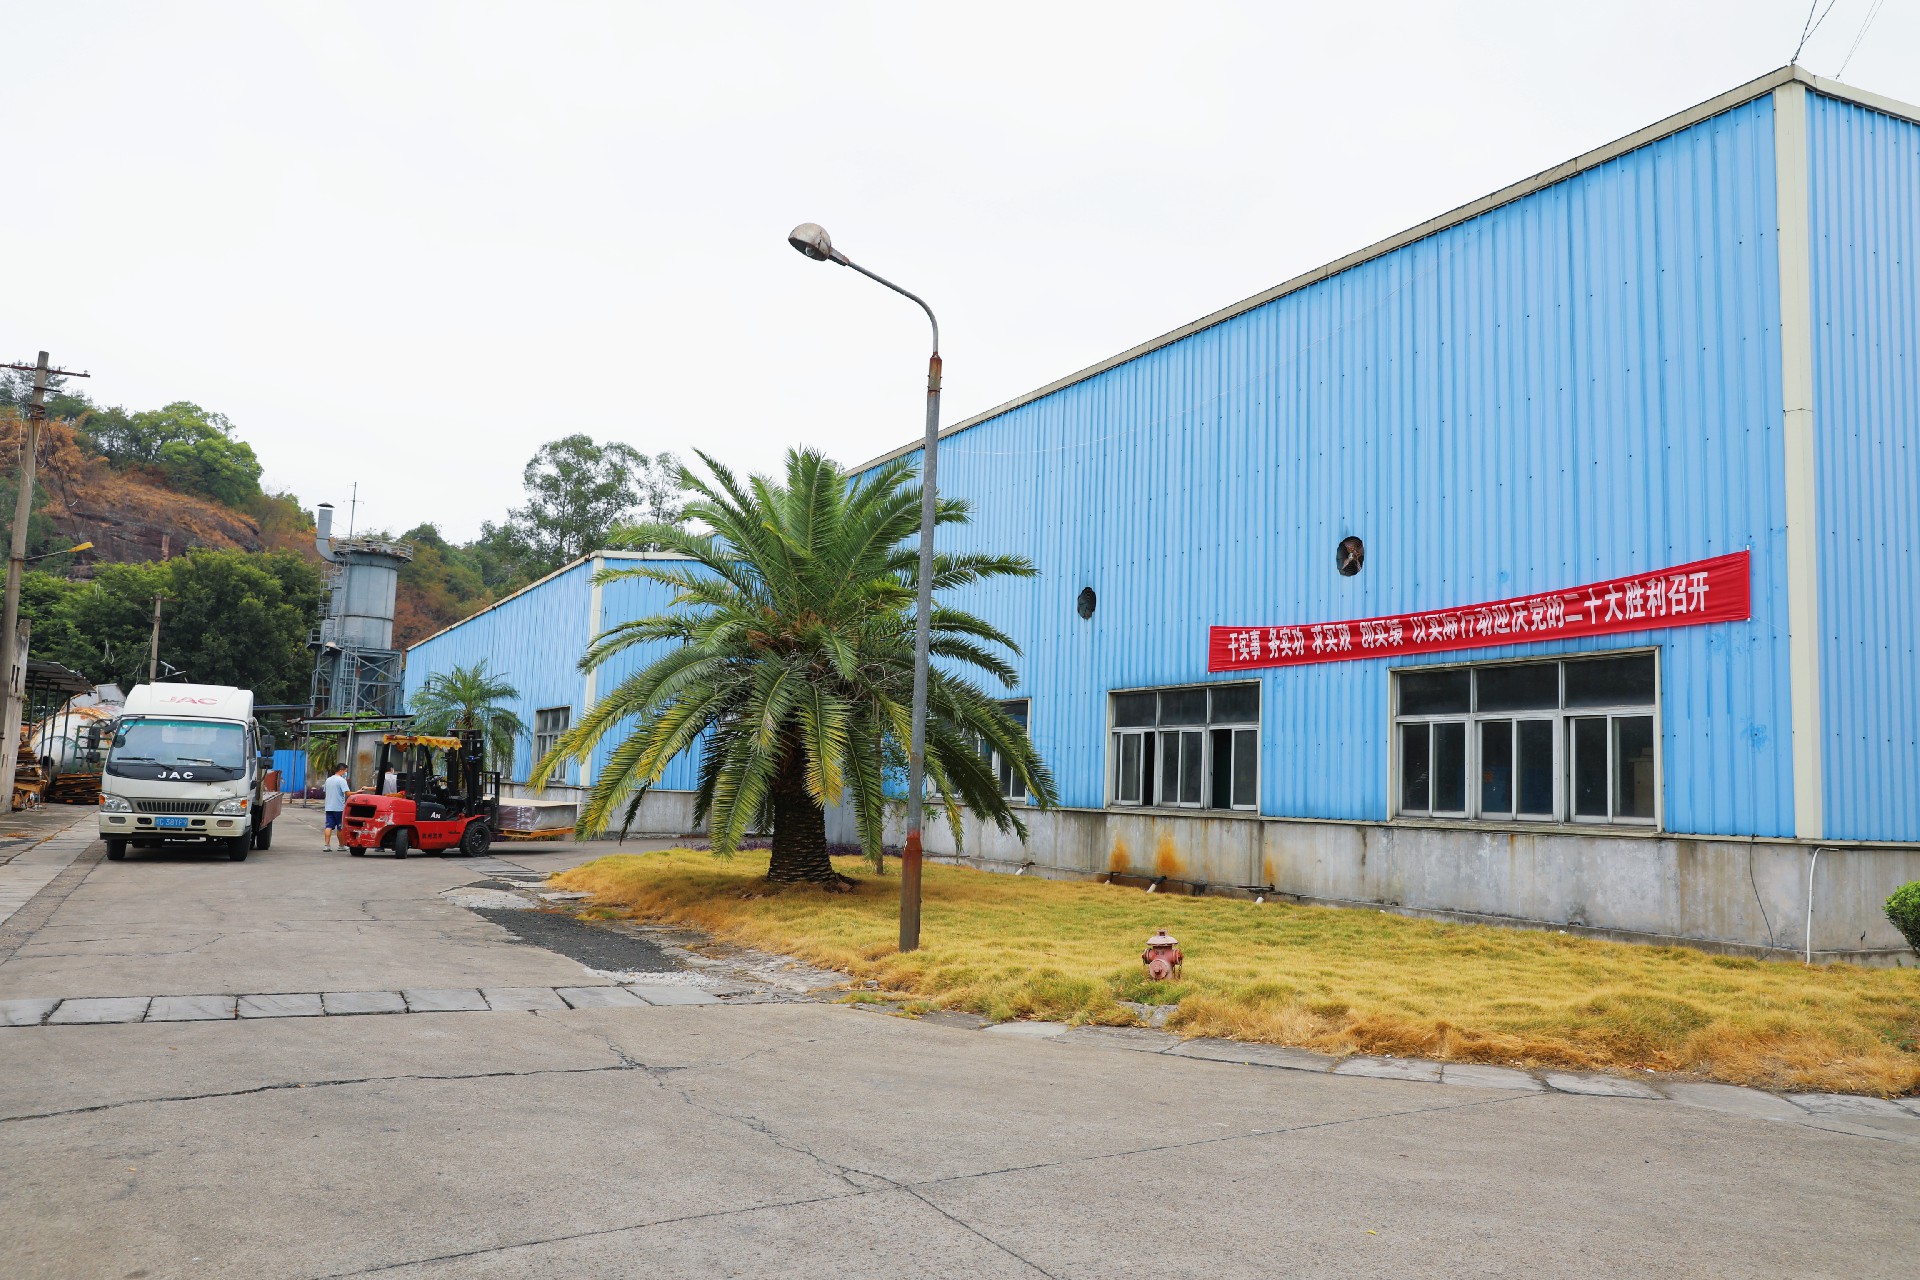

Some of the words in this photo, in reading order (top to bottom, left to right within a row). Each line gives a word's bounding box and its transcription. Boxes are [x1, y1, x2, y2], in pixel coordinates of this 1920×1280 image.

[1228, 629, 1261, 662] 干实事
[1268, 627, 1305, 659] 务实功
[1311, 623, 1352, 655] 求实效
[1359, 619, 1404, 649] 创实绩
[160, 696, 218, 706] JAC
[157, 771, 194, 780] JAC
